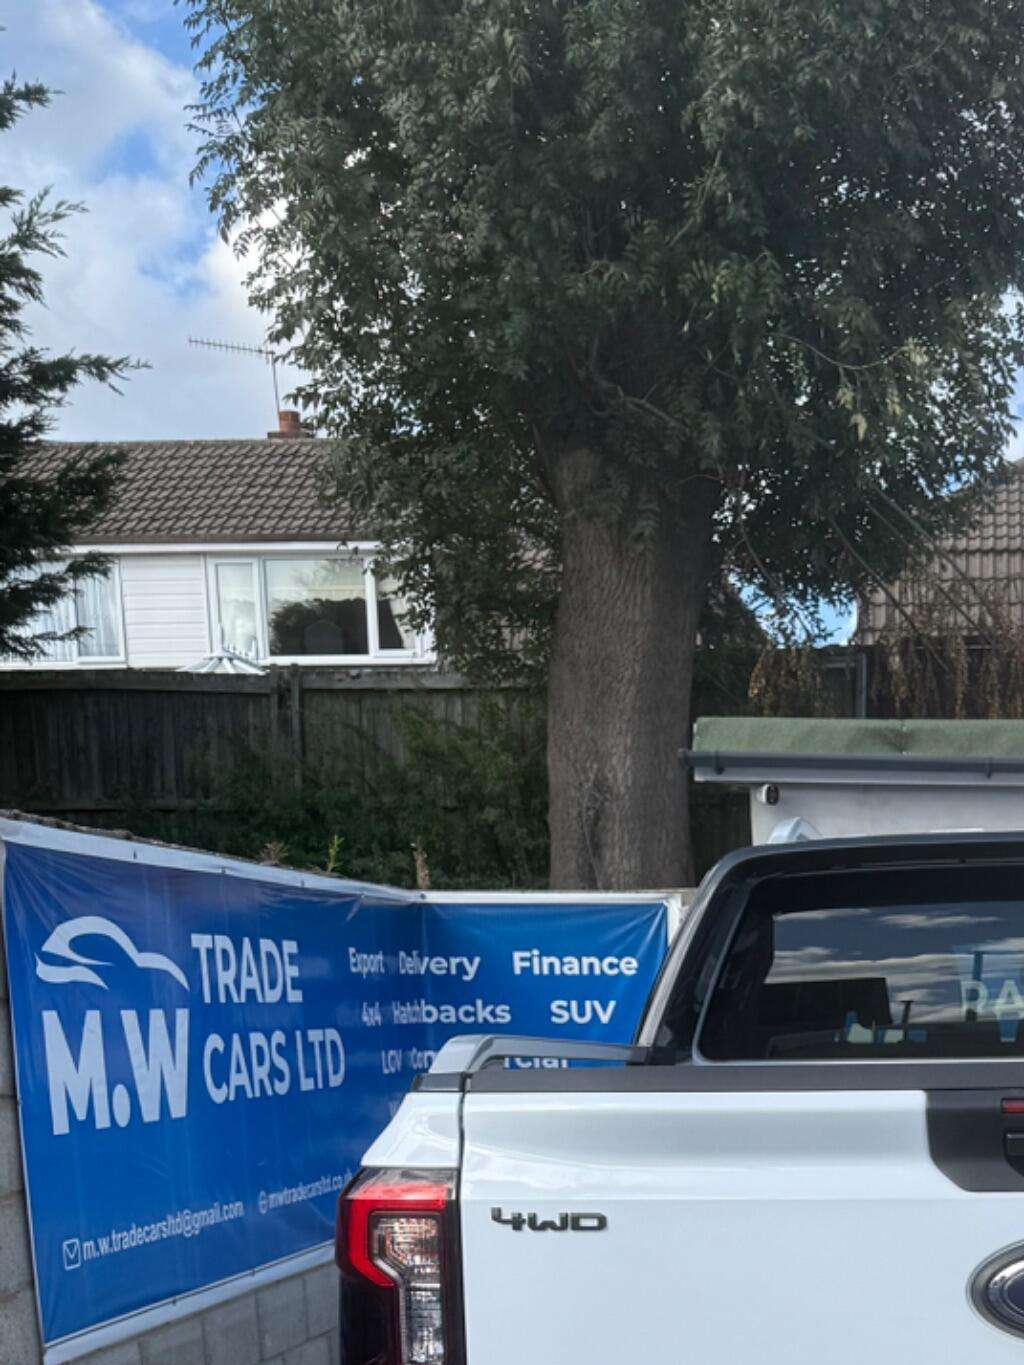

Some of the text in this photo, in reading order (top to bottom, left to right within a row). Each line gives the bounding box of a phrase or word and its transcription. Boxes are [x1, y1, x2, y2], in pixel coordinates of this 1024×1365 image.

[190, 933, 303, 1004] TRADE
[349, 947, 639, 981] Export Delivery Finance
[392, 998, 512, 1025] Hatchbacks
[550, 1000, 617, 1024] SUV
[41, 1008, 190, 1136] M.W
[203, 1028, 346, 1104] CARS LTD
[82, 1168, 352, 1262] m.w.tradecarsltd@gmail.com mwtradecarsltd.co
[490, 1206, 608, 1232] 4WD
